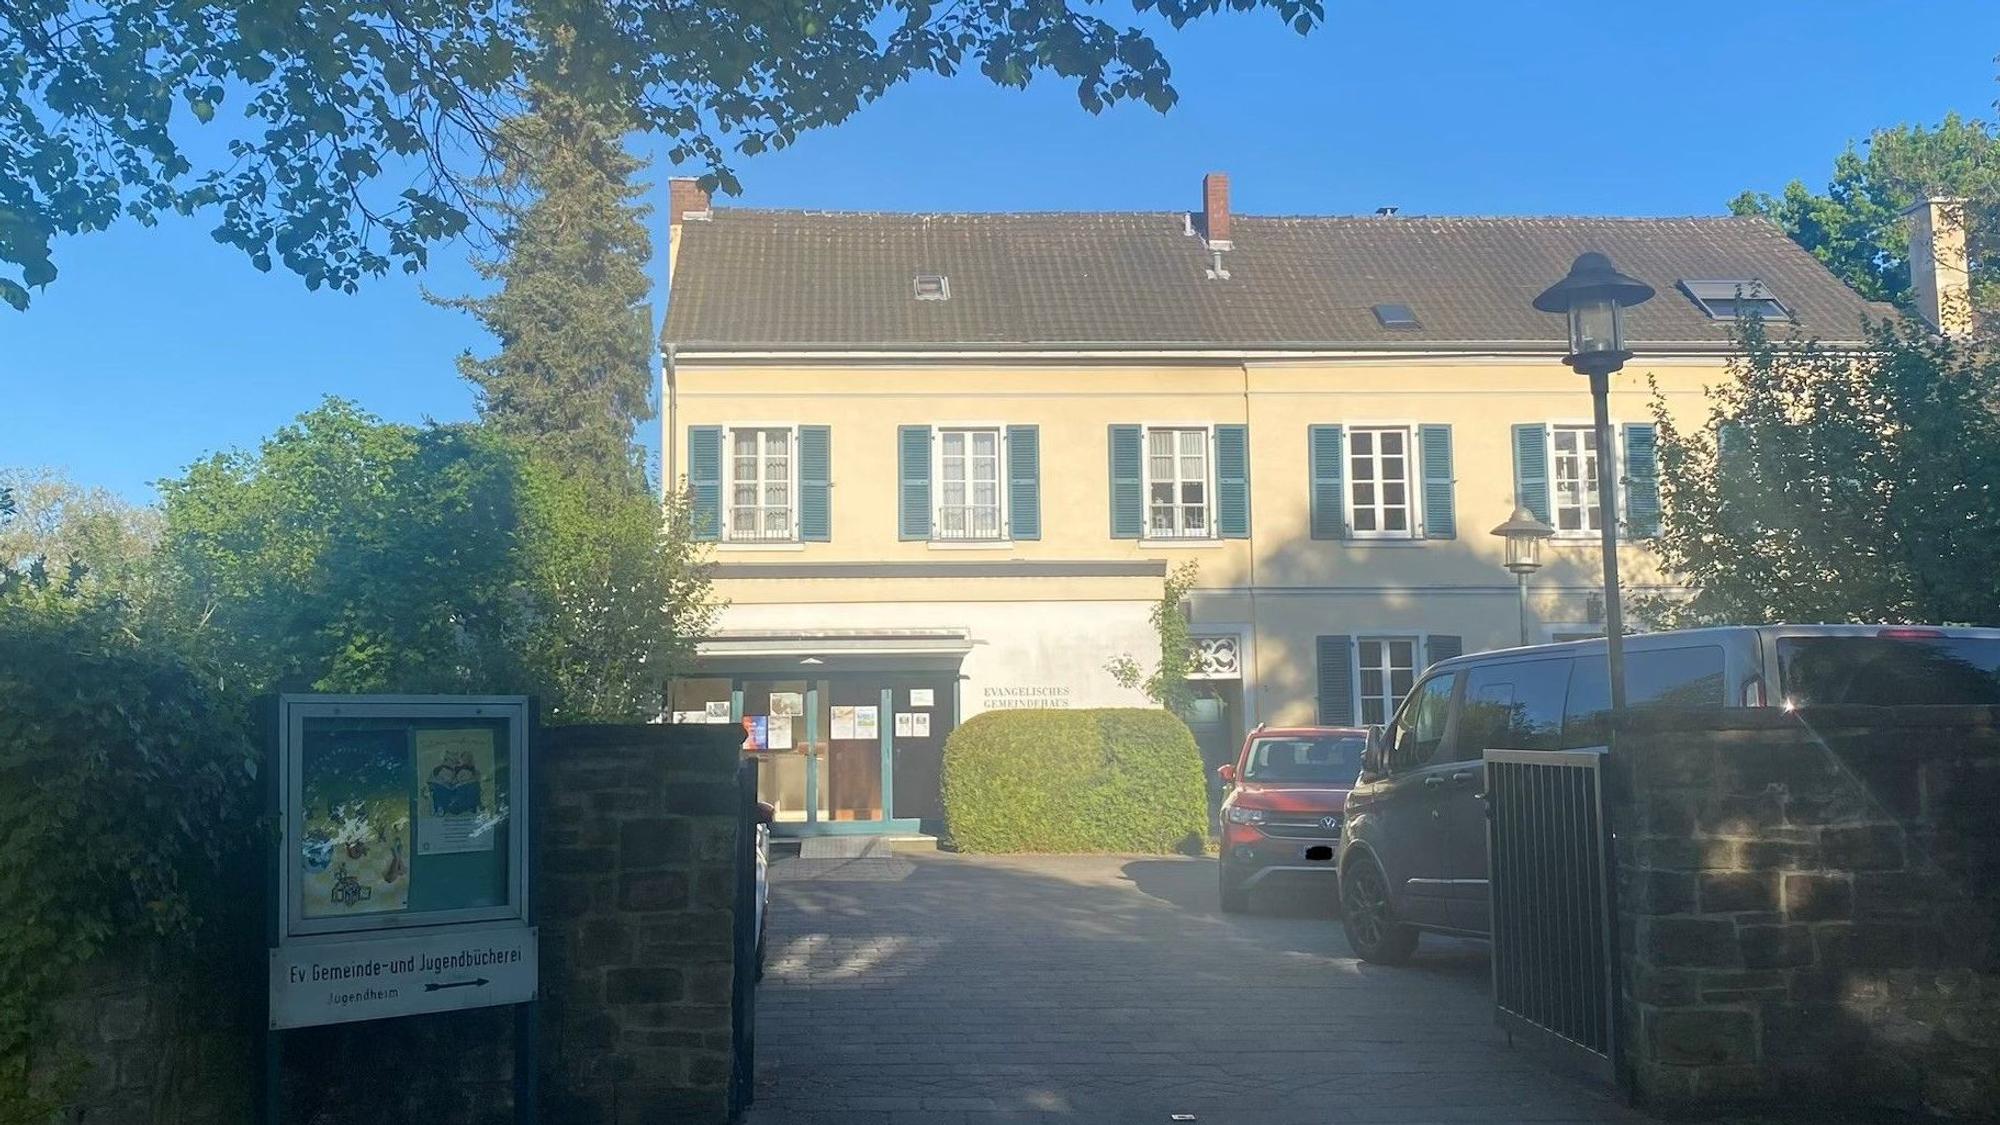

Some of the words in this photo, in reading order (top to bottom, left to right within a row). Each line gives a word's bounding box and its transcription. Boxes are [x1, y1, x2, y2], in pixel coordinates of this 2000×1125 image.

[984, 687, 1070, 697] EVANGELISCHES
[983, 698, 1069, 709] GEMEINDEHAUS
[419, 944, 522, 974] Jugendbücherei
